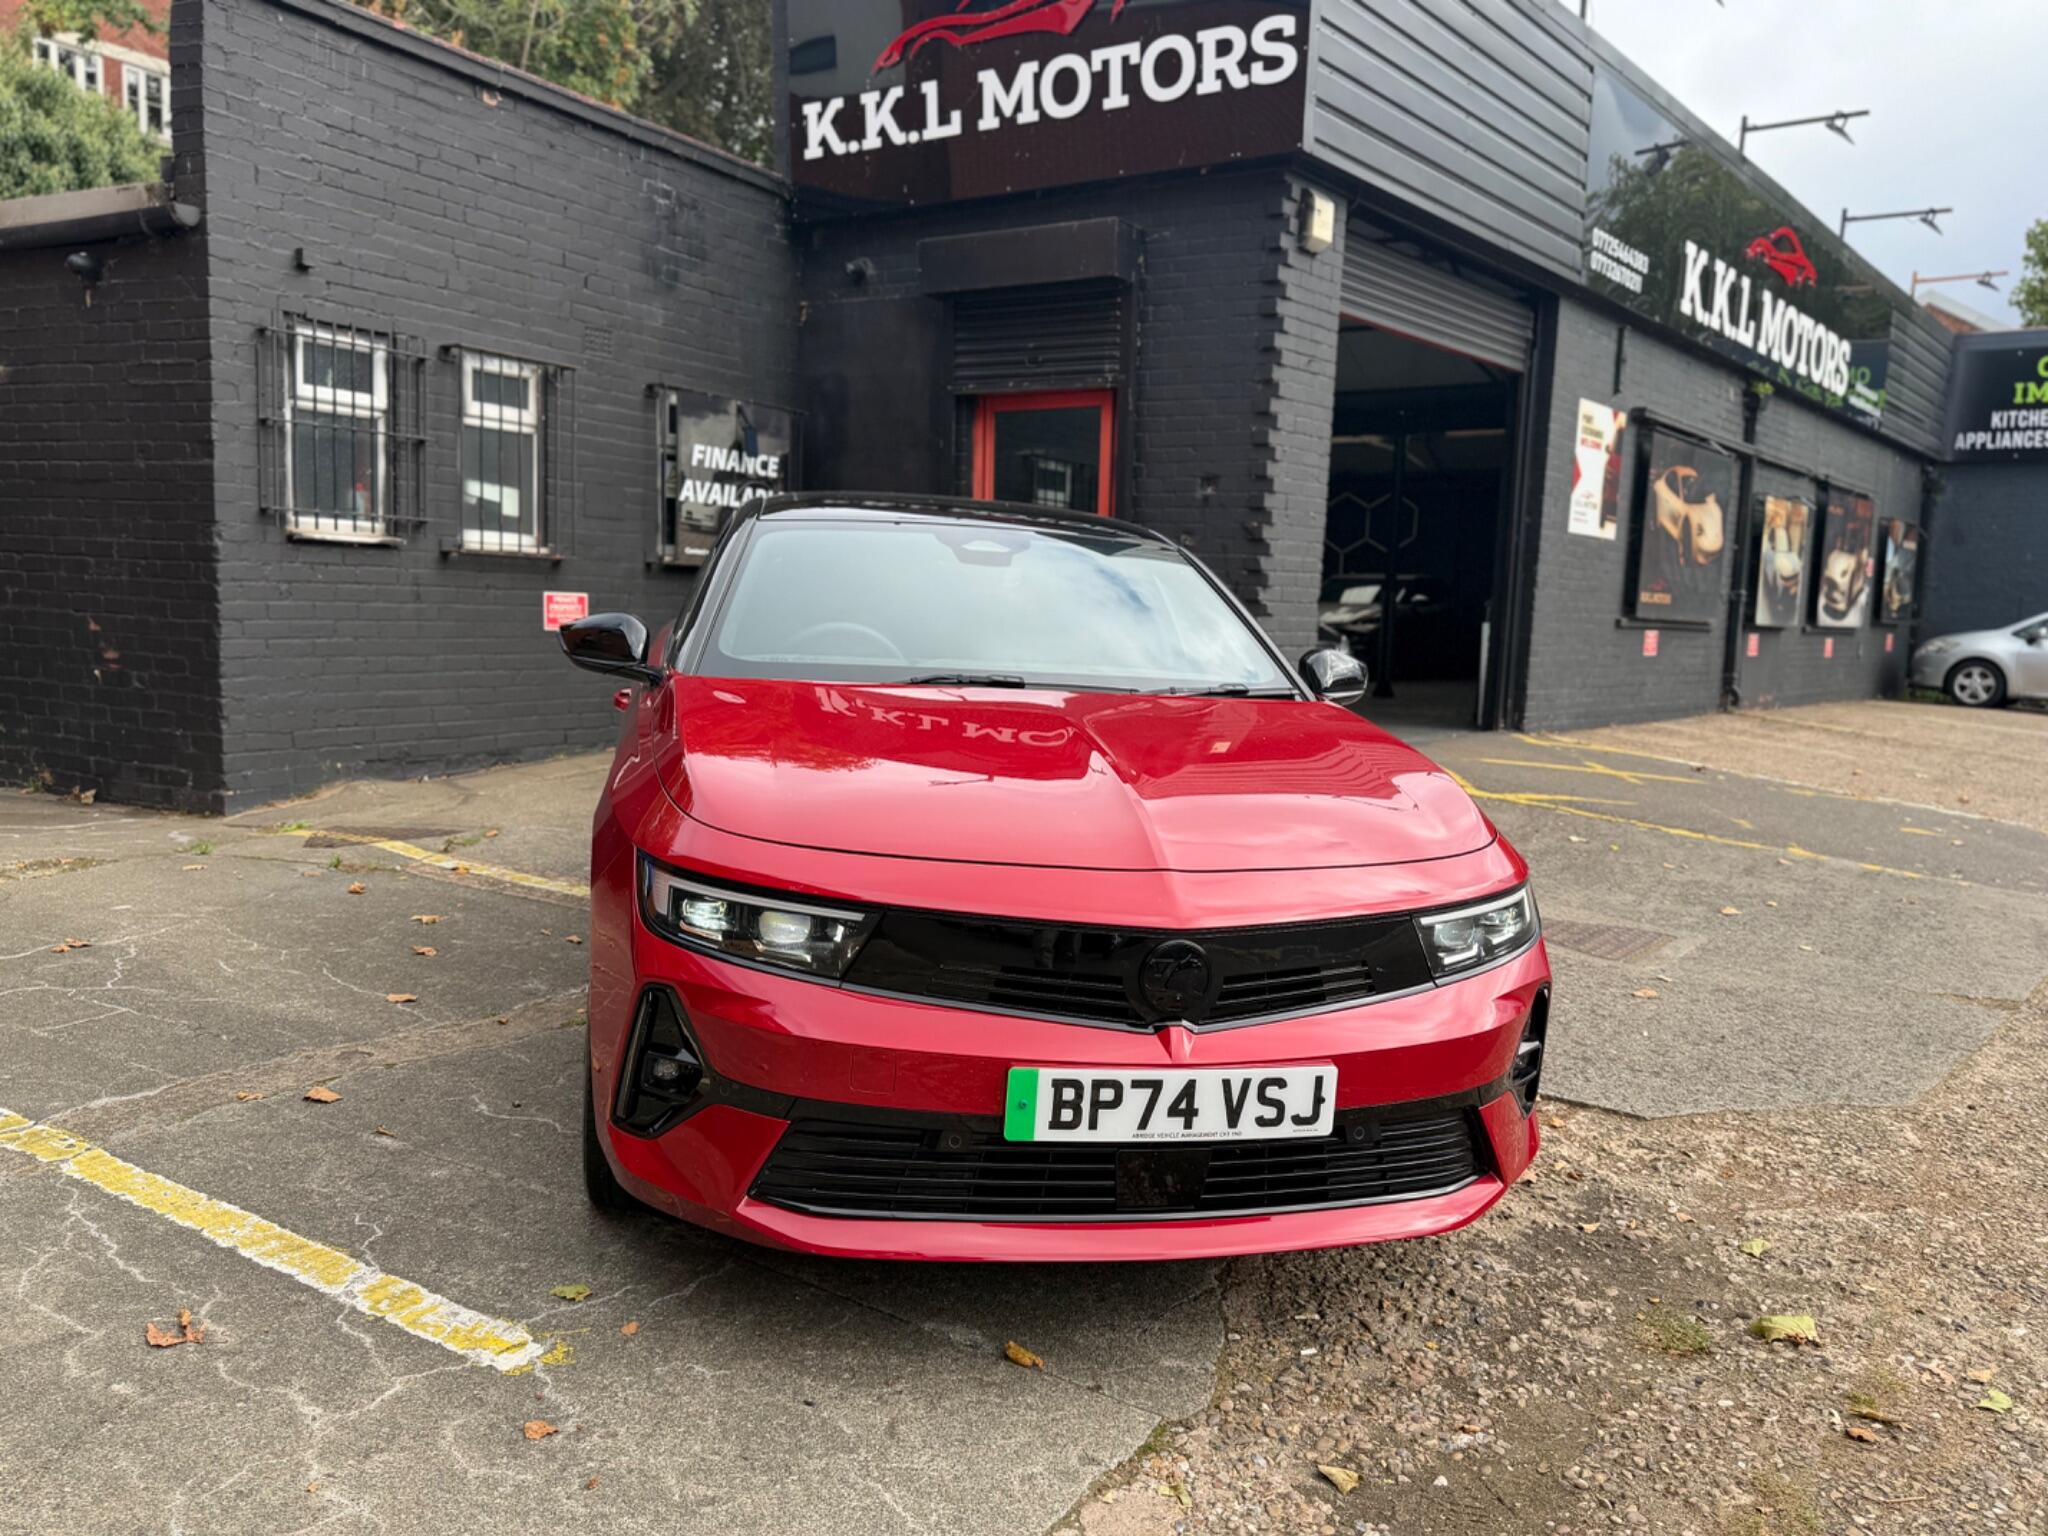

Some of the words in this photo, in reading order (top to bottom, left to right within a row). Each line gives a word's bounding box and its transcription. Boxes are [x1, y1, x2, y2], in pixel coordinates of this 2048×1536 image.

[802, 80, 962, 160] K.K.L
[977, 14, 1299, 131] MOTORS
[1756, 289, 1852, 396] MOTORS
[691, 443, 779, 478] FINANCE
[1048, 1078, 1199, 1131] BP74
[1222, 1075, 1326, 1129] VSJ
